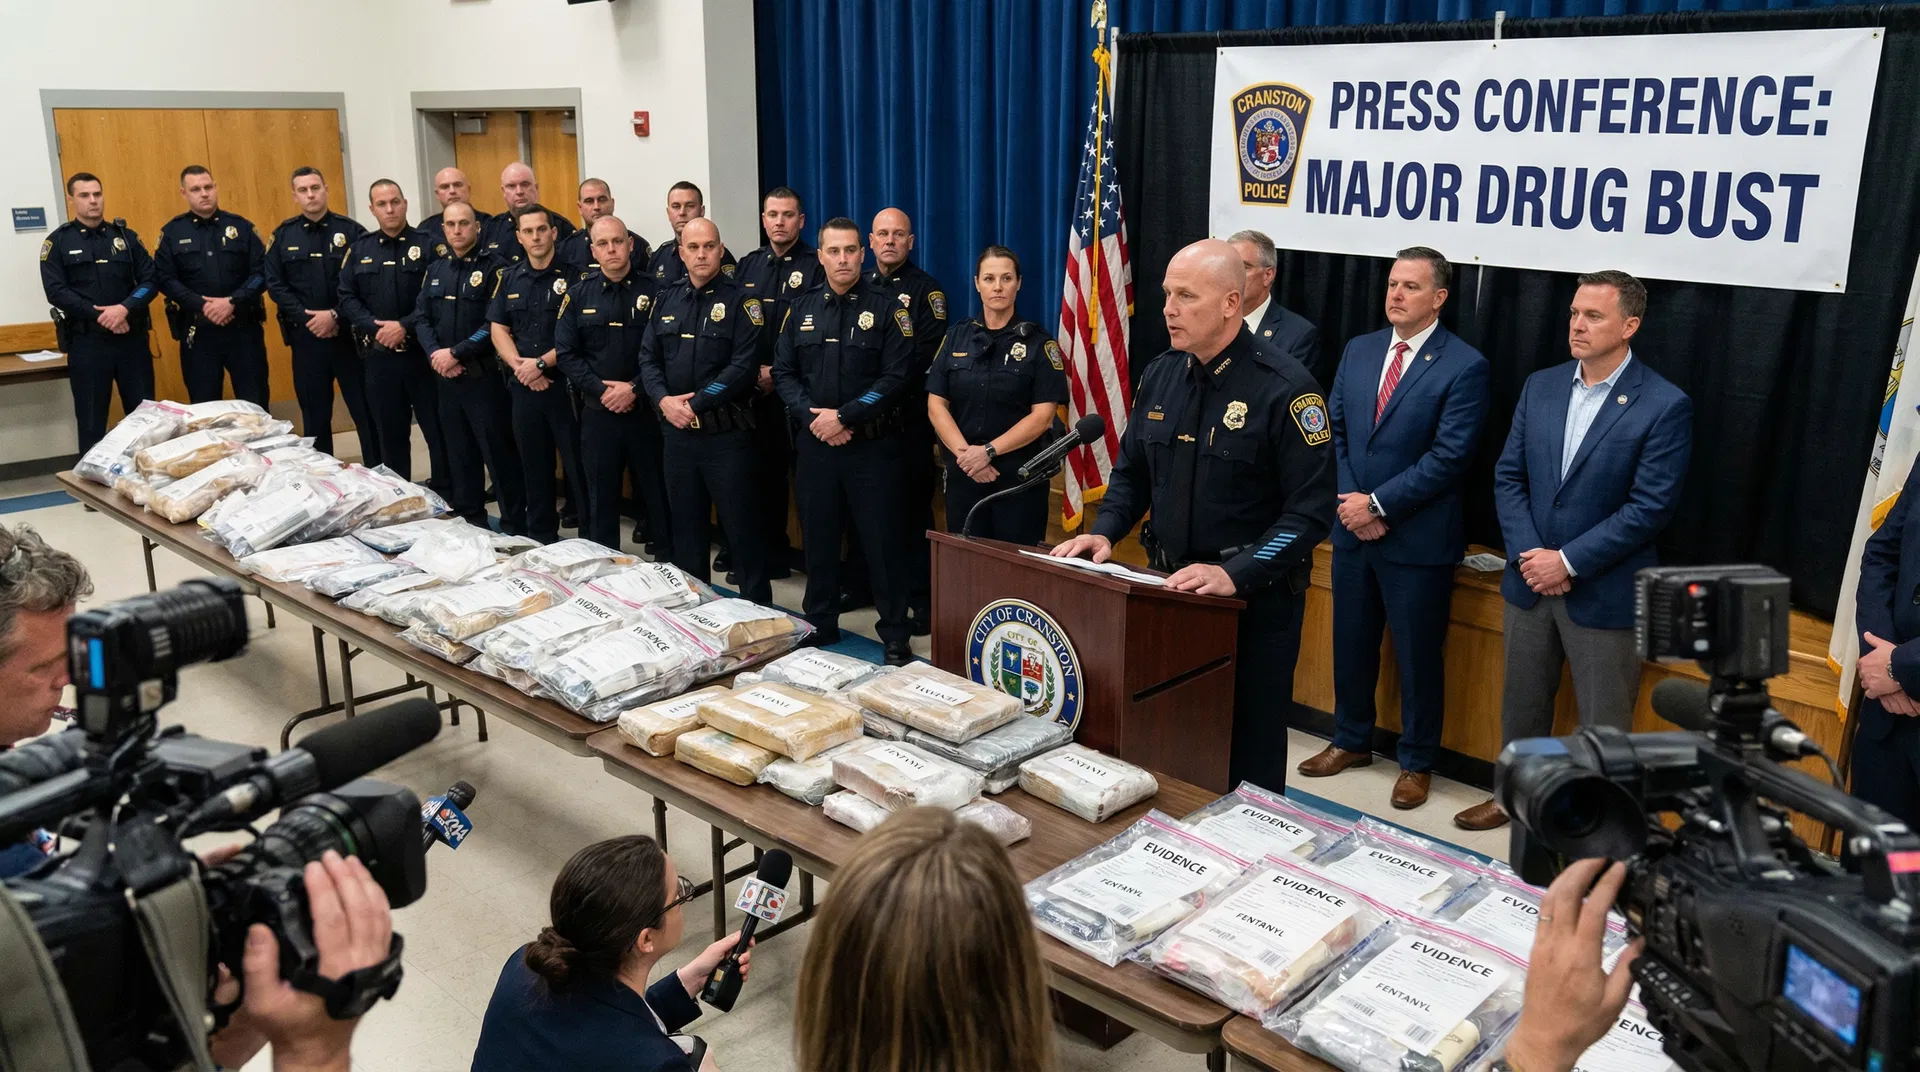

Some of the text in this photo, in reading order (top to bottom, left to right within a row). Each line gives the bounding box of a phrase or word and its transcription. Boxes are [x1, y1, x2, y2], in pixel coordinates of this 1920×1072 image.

[1237, 89, 1307, 115] CRANSTON
[1329, 75, 1832, 136] PRESS CONFERENCE:
[1244, 182, 1287, 200] POLICE
[1306, 158, 1820, 243] MAJOR DRUG BUST
[974, 606, 1075, 677] CITY OF CRANSTON
[1007, 630, 1025, 642] CITY
[1241, 807, 1304, 836] EVIDENCE
[1143, 841, 1208, 876] EVIDENCE
[1368, 849, 1438, 879] EVIDENCE
[1272, 875, 1347, 908] EVIDENCE
[1235, 911, 1286, 938] FENTANYL
[1410, 940, 1494, 978] EVIDENCE
[1375, 982, 1432, 1013] FENTANYL
